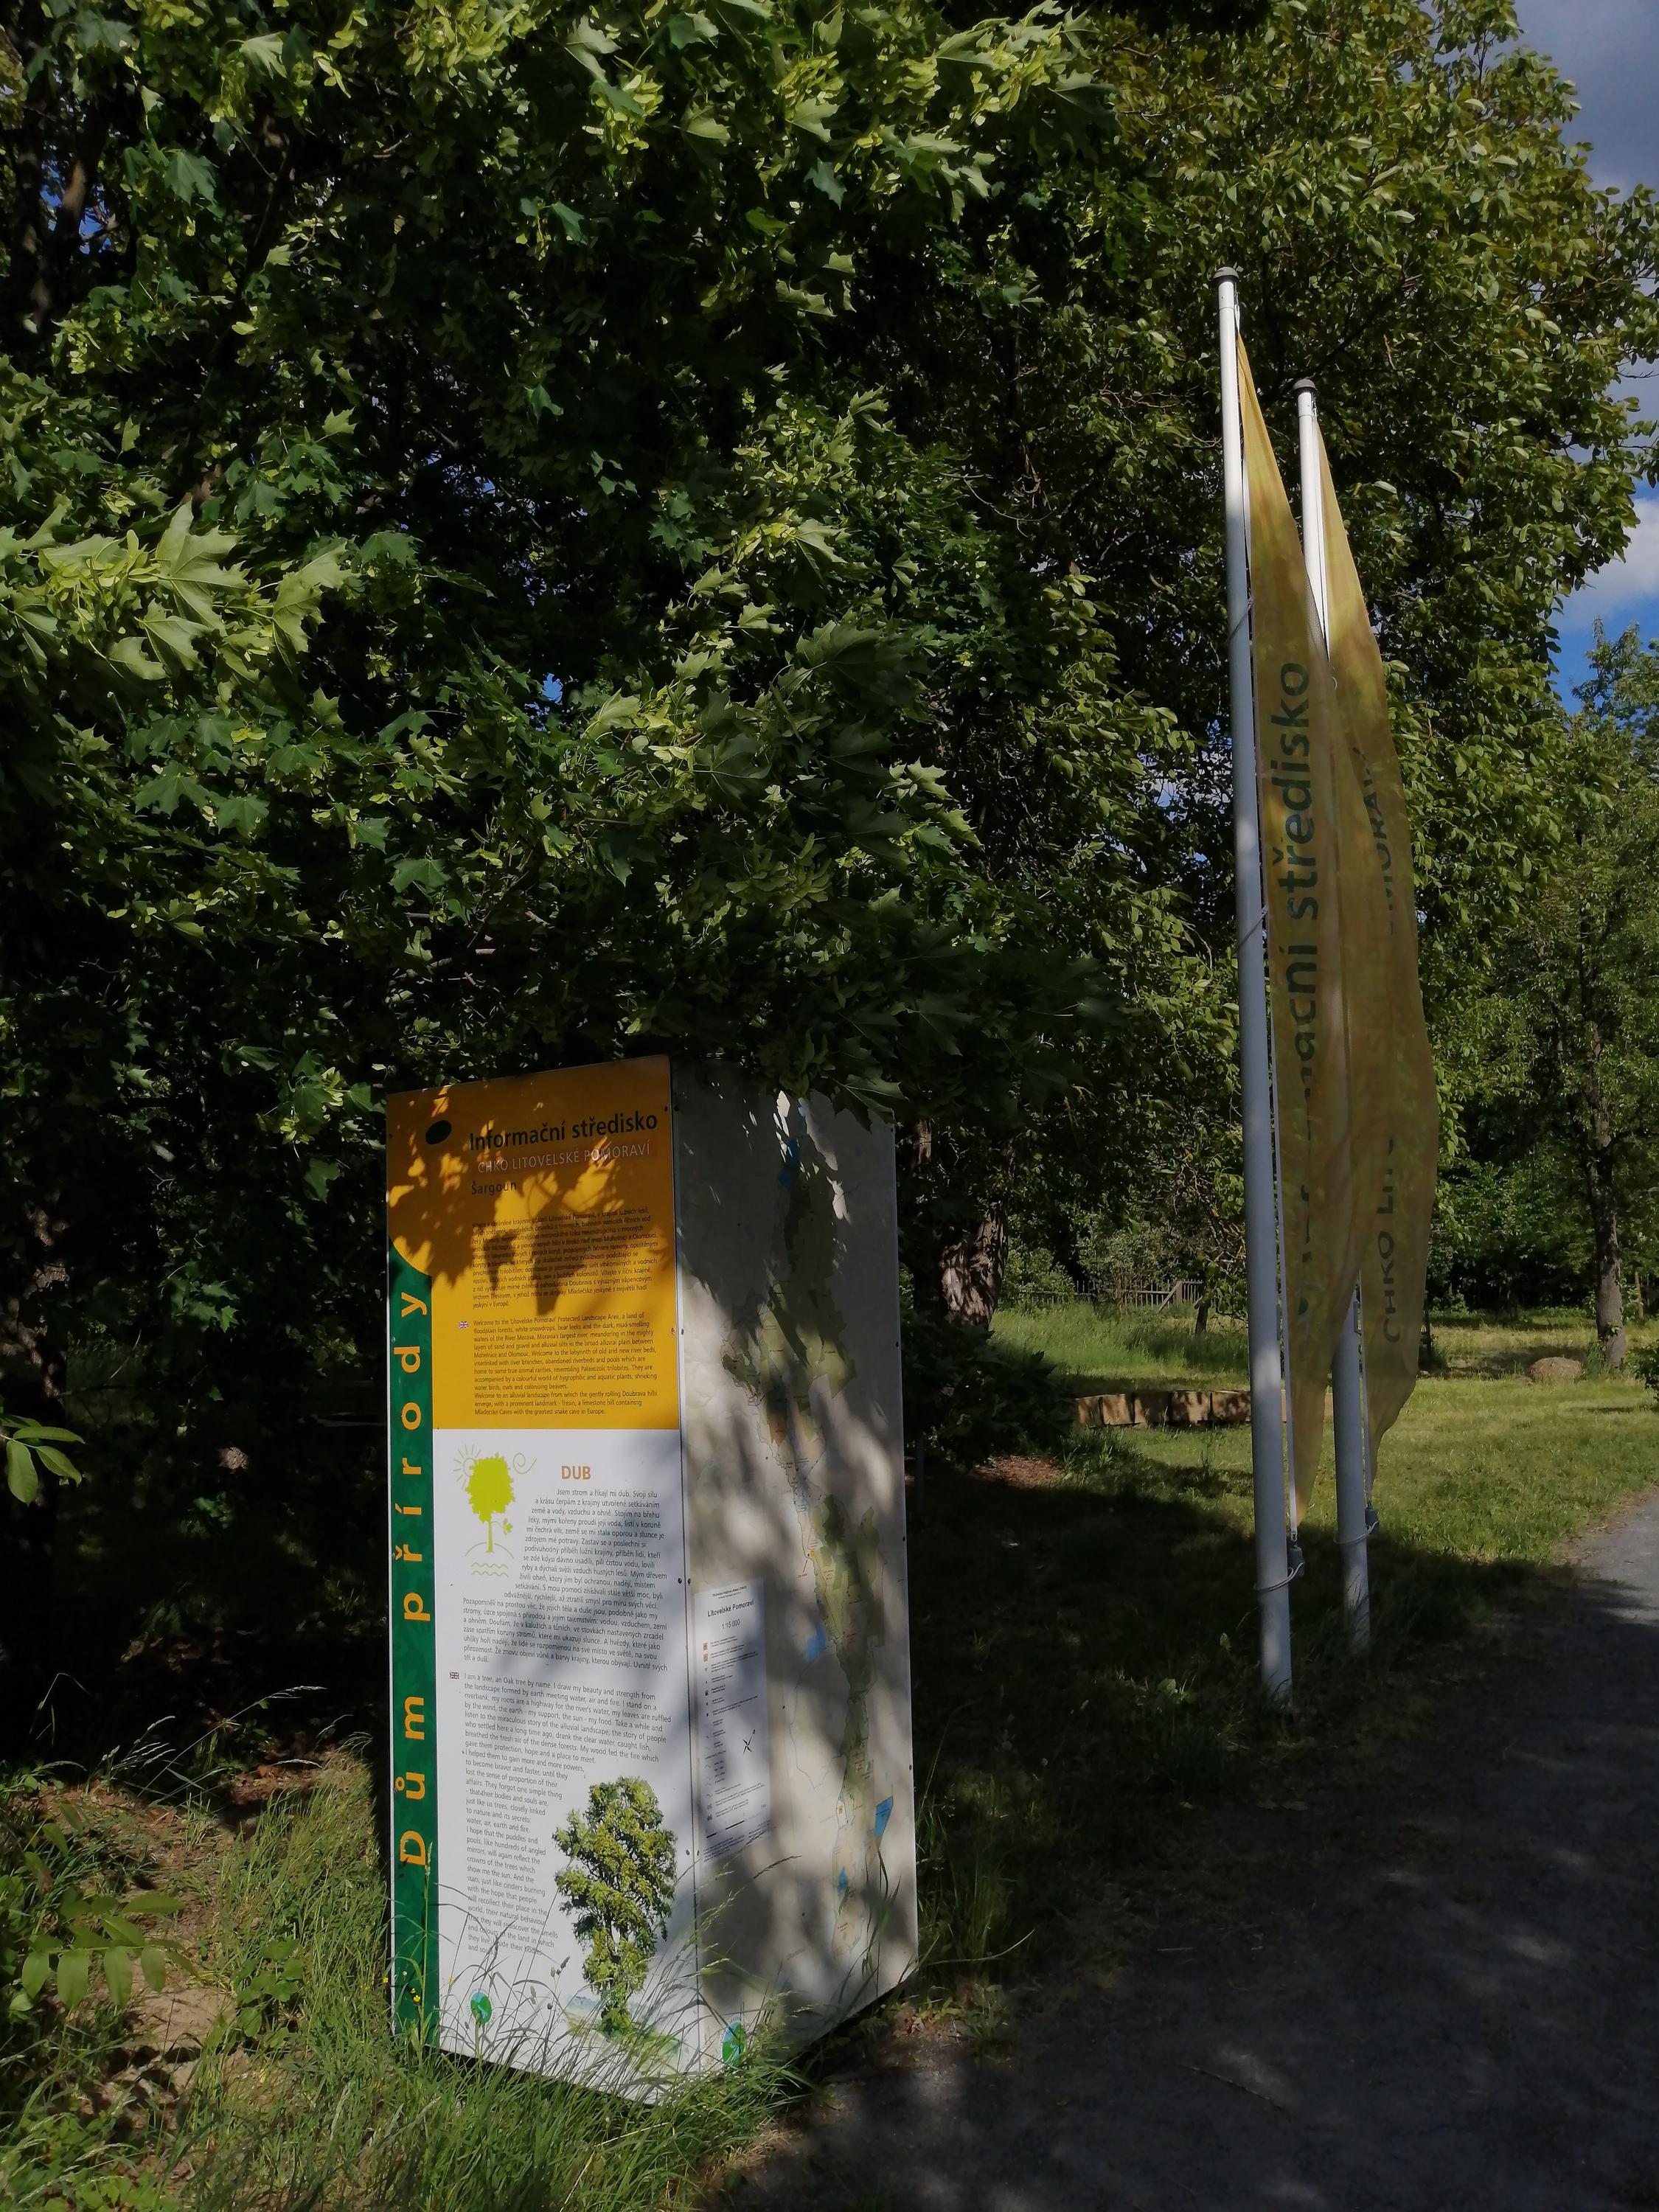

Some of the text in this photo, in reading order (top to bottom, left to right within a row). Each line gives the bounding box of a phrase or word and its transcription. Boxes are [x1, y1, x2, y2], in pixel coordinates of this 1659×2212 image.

[1270, 662, 1319, 921] středisko
[469, 1110, 658, 1151] Informační středisko
[478, 1141, 650, 1173] CHKO LITOVELSKÉ POMORAVÍ
[471, 1180, 517, 1196] Šargoun
[1377, 1231, 1400, 1343] CHKO
[561, 1465, 591, 1480] DUB
[582, 1499, 599, 1507] krajiny
[525, 1535, 546, 1543] zdrojem
[613, 1540, 640, 1548] poslechni
[394, 1292, 431, 1866] Dům přírody
[474, 1683, 500, 1694] landscape
[522, 1689, 529, 1697] by
[546, 1692, 568, 1702] meeting
[527, 1680, 534, 1688] by
[582, 1686, 602, 1695] beauty
[616, 1690, 639, 1700] strength
[531, 1700, 554, 1710] highway
[622, 1711, 639, 1719] leaves
[652, 1714, 671, 1722] ruffled
[524, 1747, 538, 1756] hope
[556, 1752, 571, 1761] place
[469, 1827, 483, 1836] hope
[505, 1833, 526, 1843] puddles
[494, 1841, 519, 1851] hundreds
[528, 1846, 546, 1857] angled
[467, 1885, 479, 1893] with
[490, 1889, 505, 1899] hope
[518, 1894, 537, 1905] people
